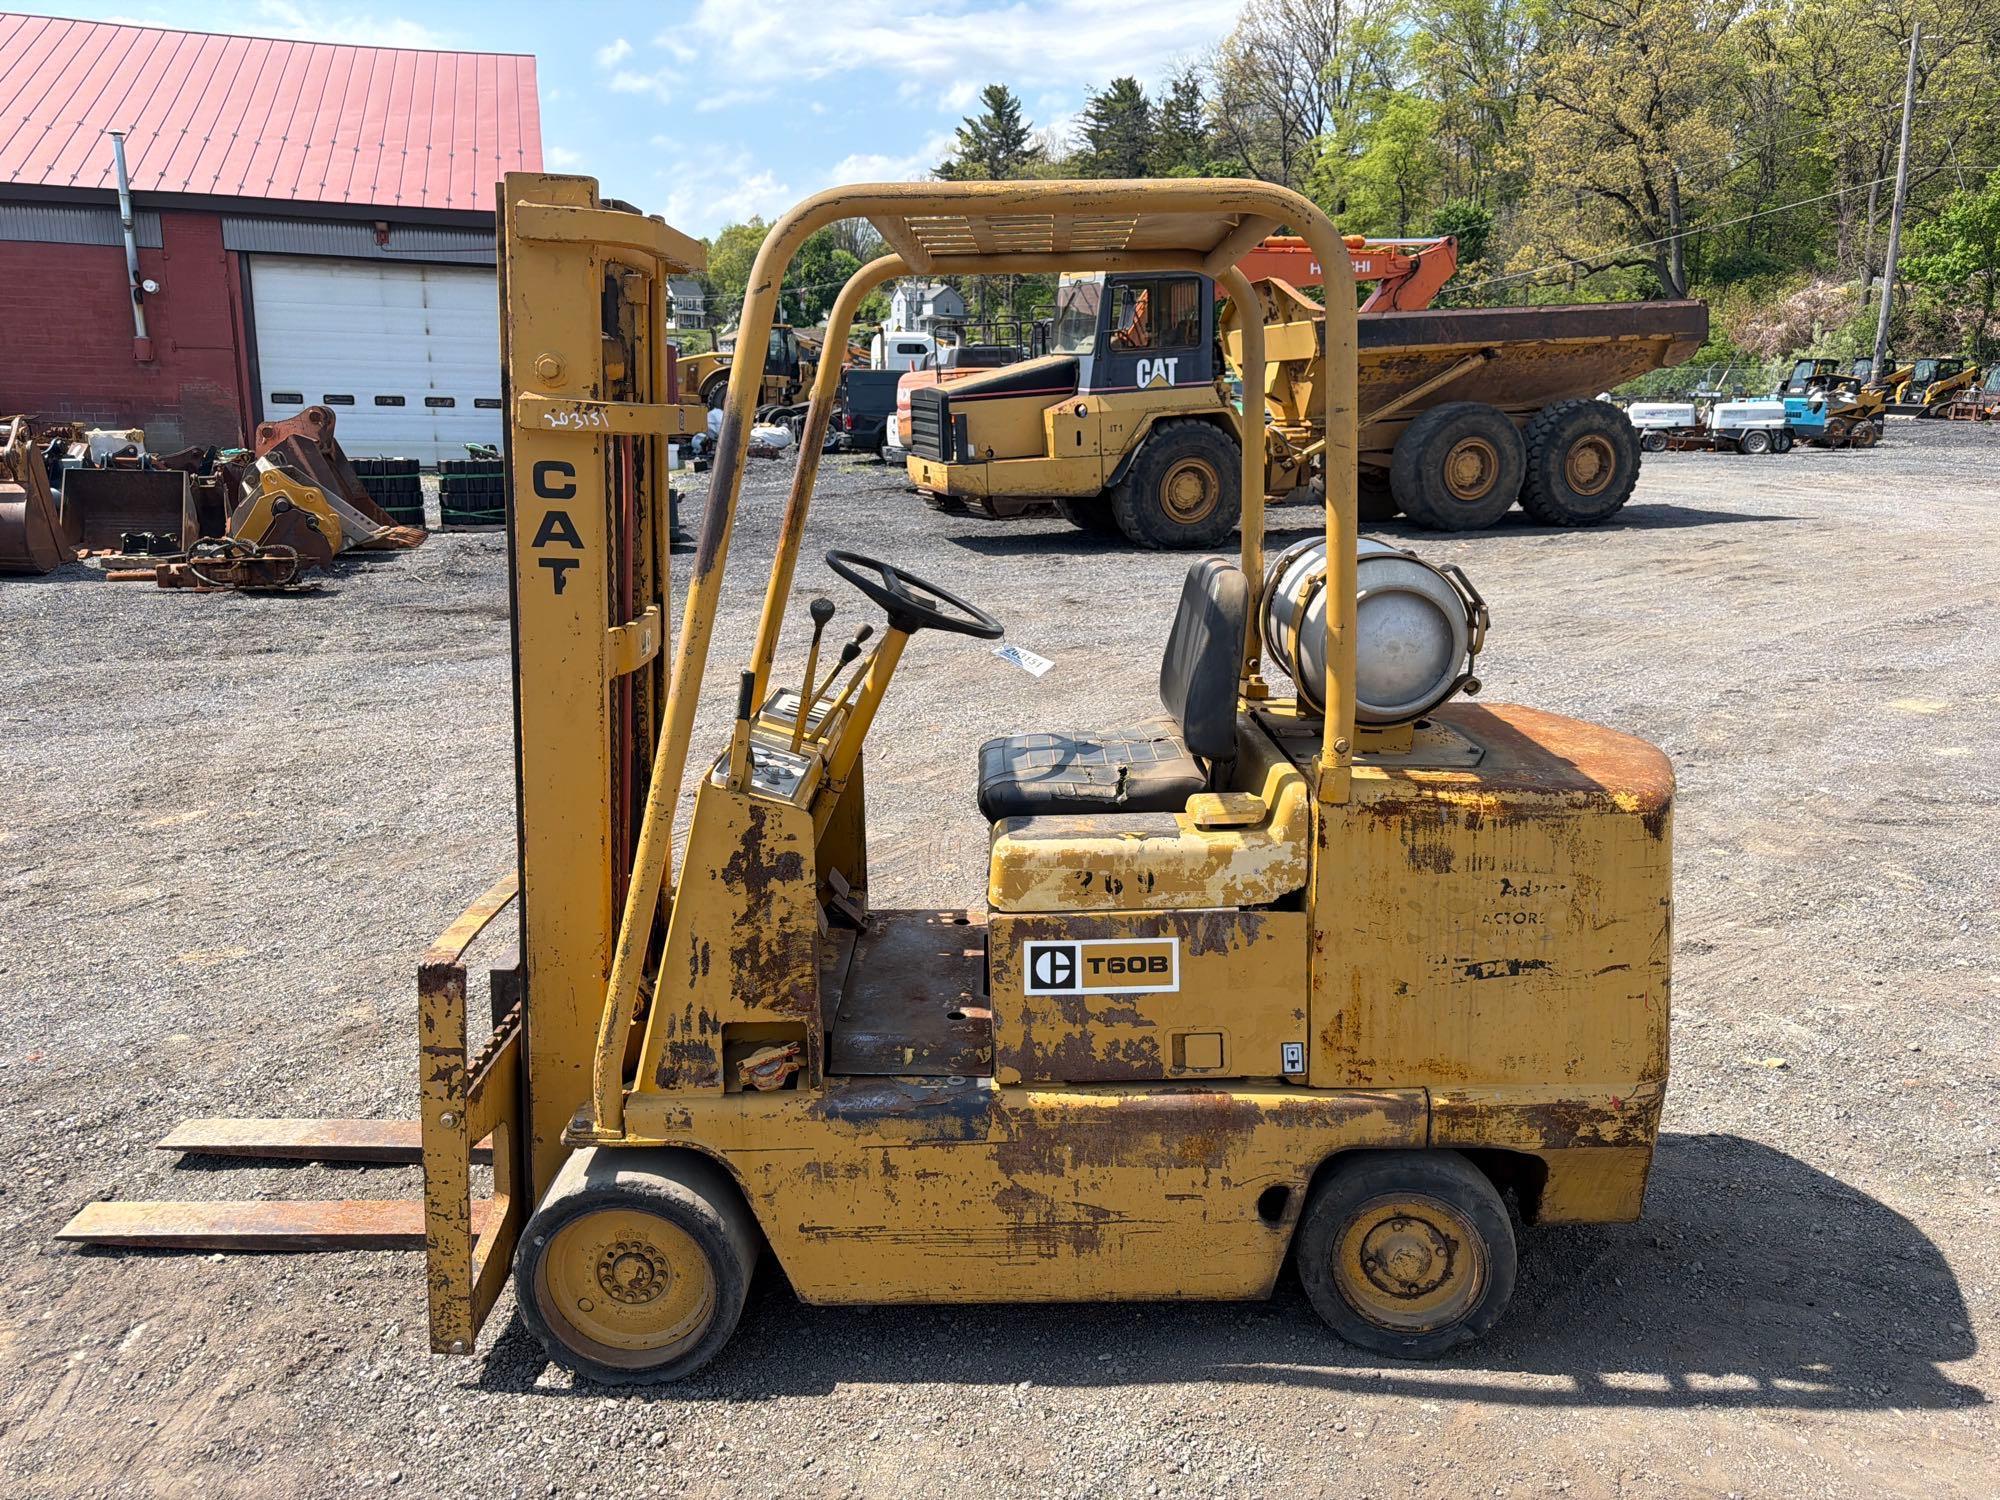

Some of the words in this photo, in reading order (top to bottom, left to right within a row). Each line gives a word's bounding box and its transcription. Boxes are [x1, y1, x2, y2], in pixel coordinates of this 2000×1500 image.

[1136, 357, 1179, 389] CAT
[544, 411, 609, 429] 203151
[531, 460, 585, 595] CAT
[1086, 956, 1169, 975] T60B
